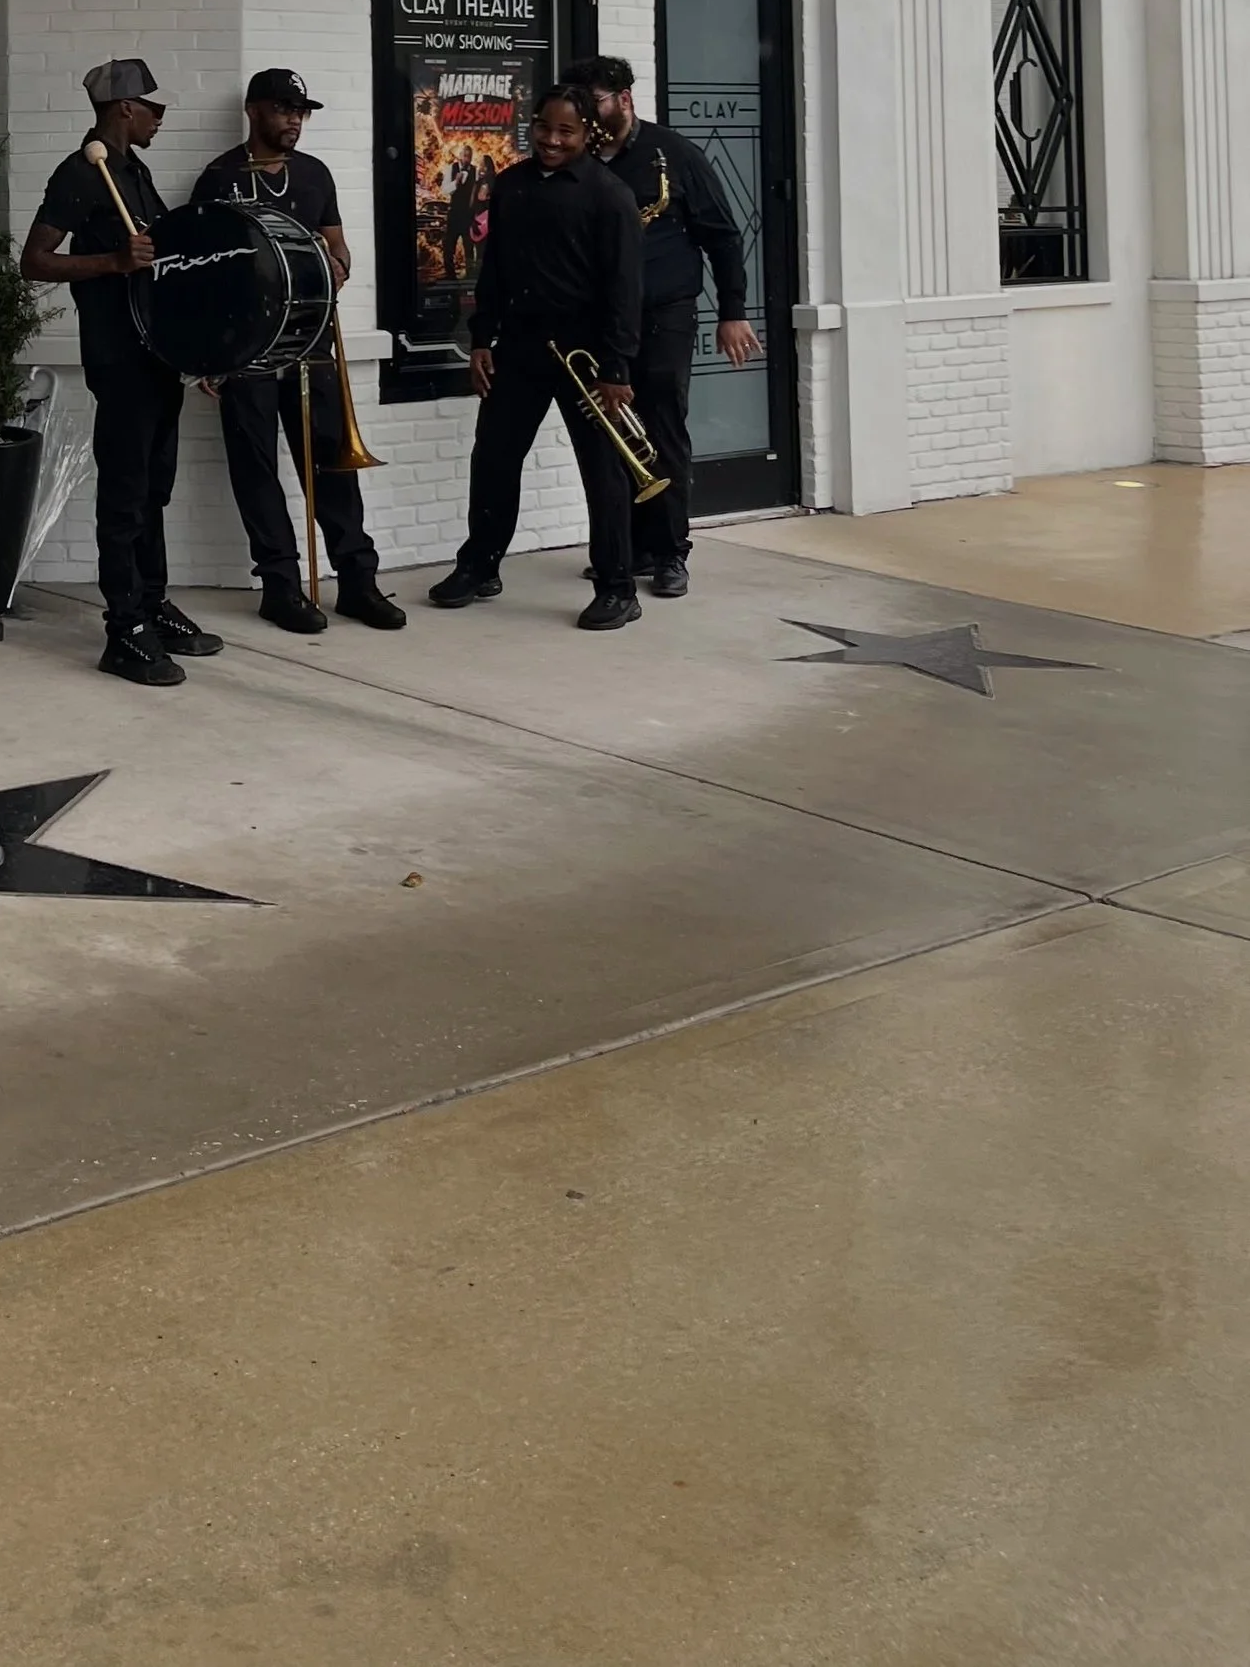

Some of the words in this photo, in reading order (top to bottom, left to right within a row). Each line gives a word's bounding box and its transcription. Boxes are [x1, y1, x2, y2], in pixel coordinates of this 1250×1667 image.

[425, 34, 455, 49] NOW
[459, 34, 512, 51] SHOWING
[438, 73, 513, 100] MARRIAGE
[440, 102, 514, 125] MISSION
[690, 101, 737, 119] CLAY
[151, 248, 258, 281] Trixon
